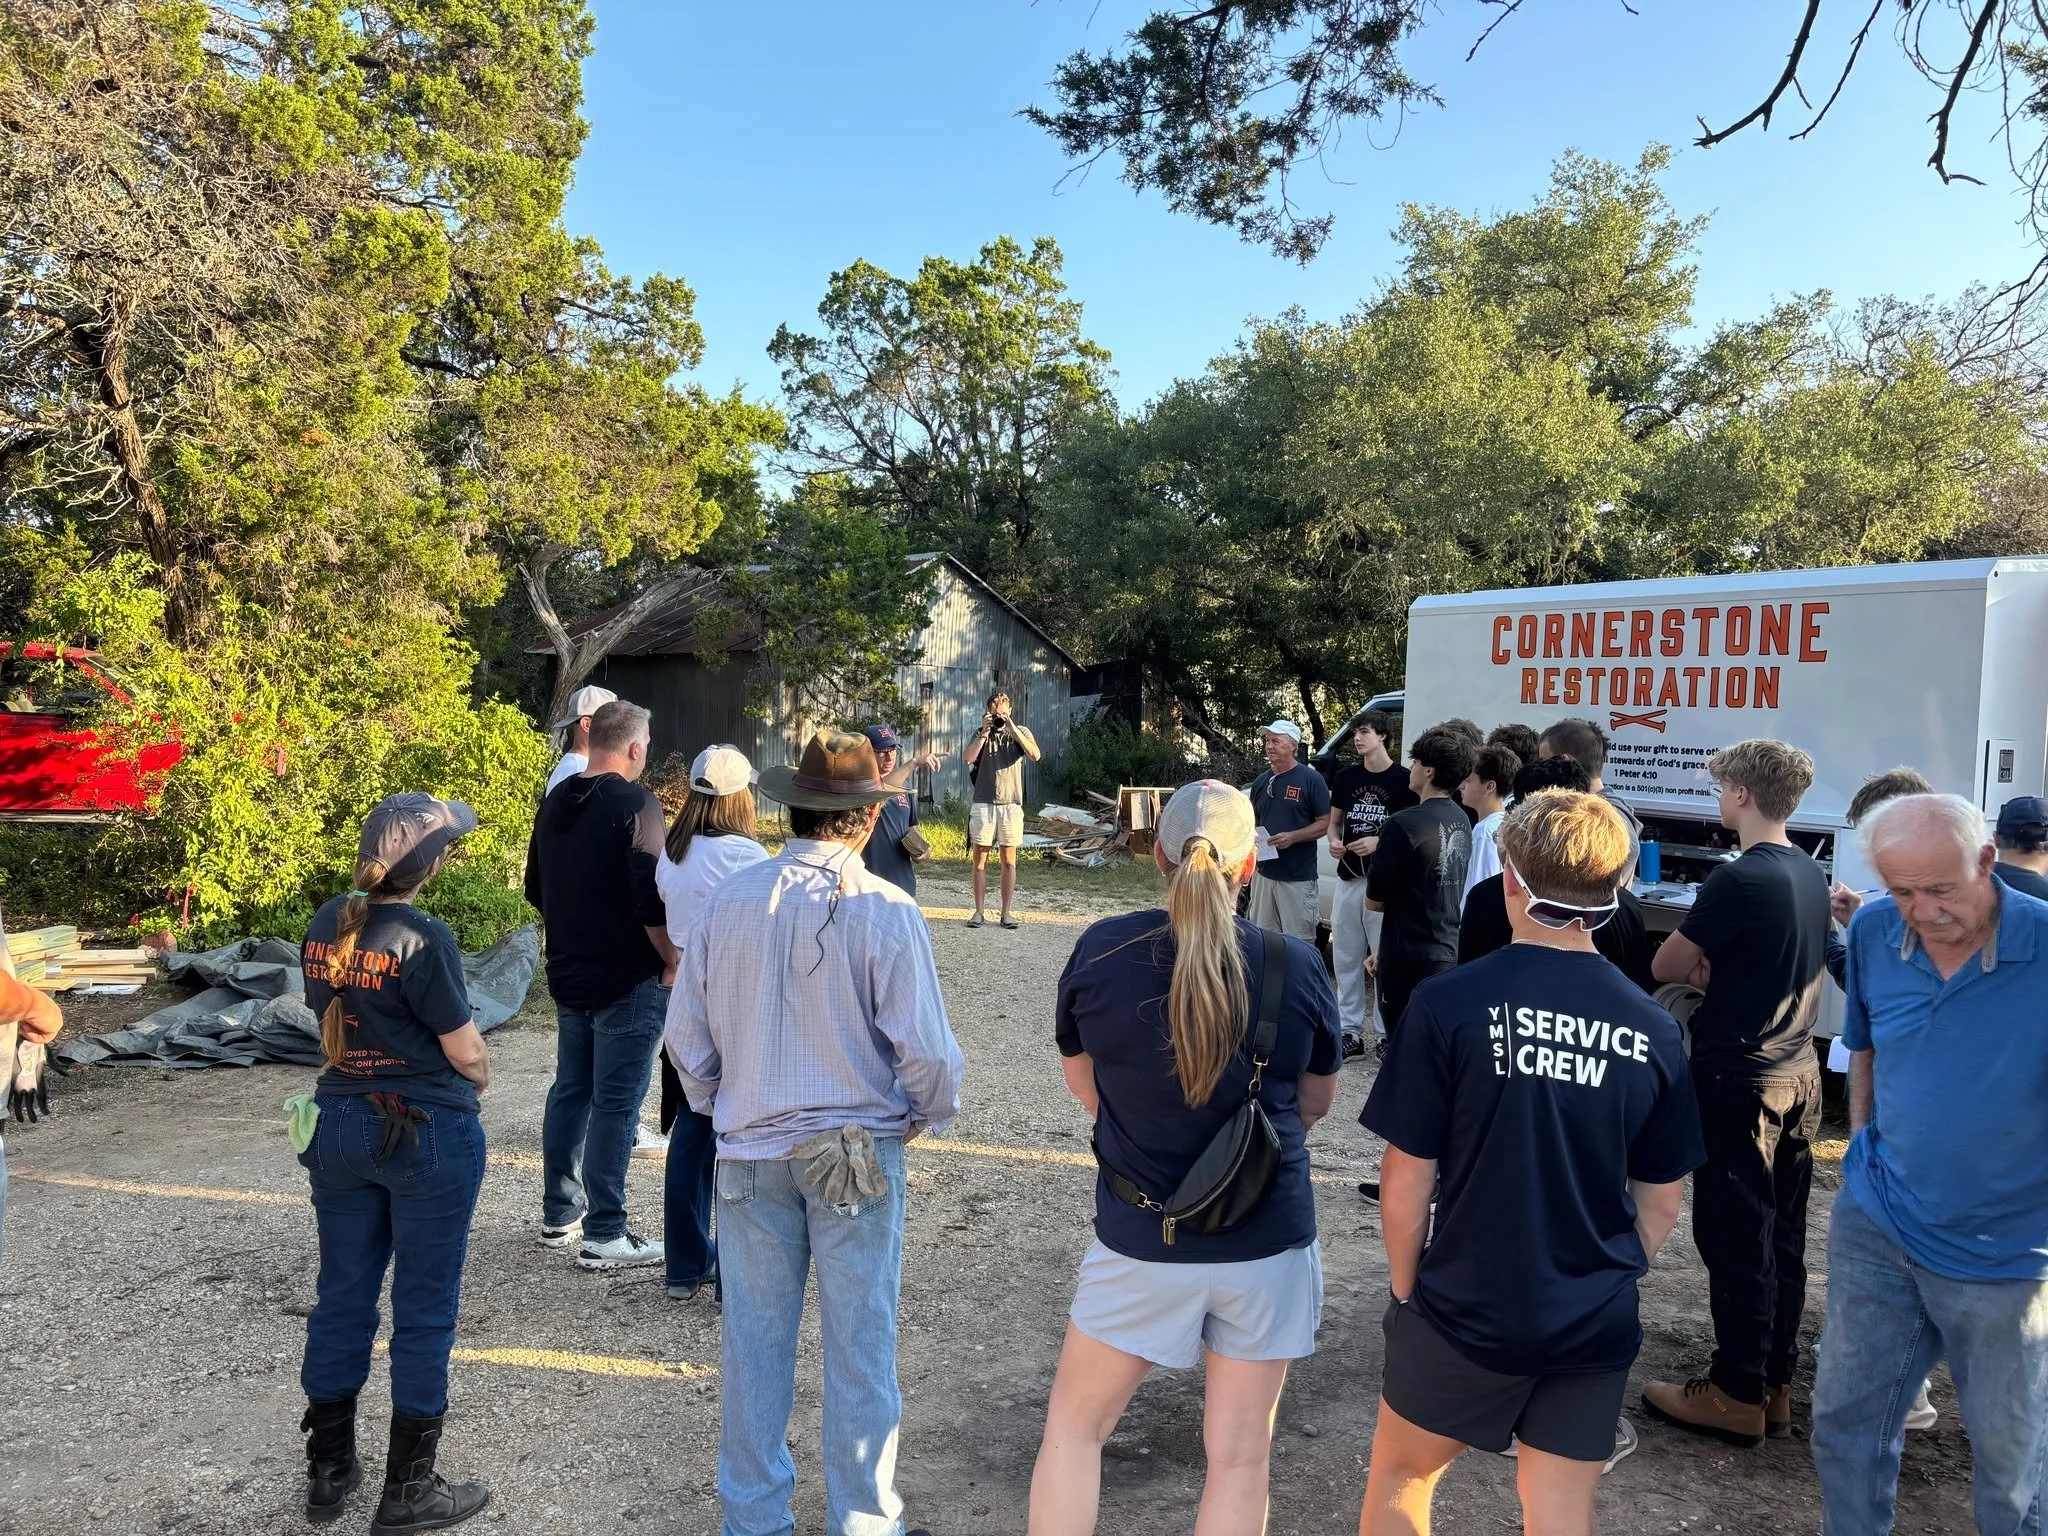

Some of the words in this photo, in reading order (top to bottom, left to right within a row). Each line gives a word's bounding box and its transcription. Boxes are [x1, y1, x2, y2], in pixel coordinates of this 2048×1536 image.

[1491, 602, 1830, 665] CORNERSTONE
[1521, 666, 1781, 709] RESTORATION
[1618, 744, 1632, 752] use
[1633, 745, 1651, 754] your
[1653, 745, 1669, 754] gift
[1670, 746, 1679, 754] to
[1681, 747, 1704, 756] serve
[1609, 756, 1645, 766] stewards
[1646, 757, 1655, 766] of
[1657, 758, 1680, 768] God's
[1682, 761, 1708, 770] grace.
[1614, 769, 1618, 777] 1
[1619, 769, 1640, 778] Peter
[1642, 771, 1658, 780] 4:10
[1637, 786, 1664, 794] 501(c)(3)
[1678, 788, 1694, 797] profit
[1353, 803, 1385, 814] STATE
[1515, 1007, 1650, 1063] SERVICE
[1515, 1044, 1608, 1088] CREW
